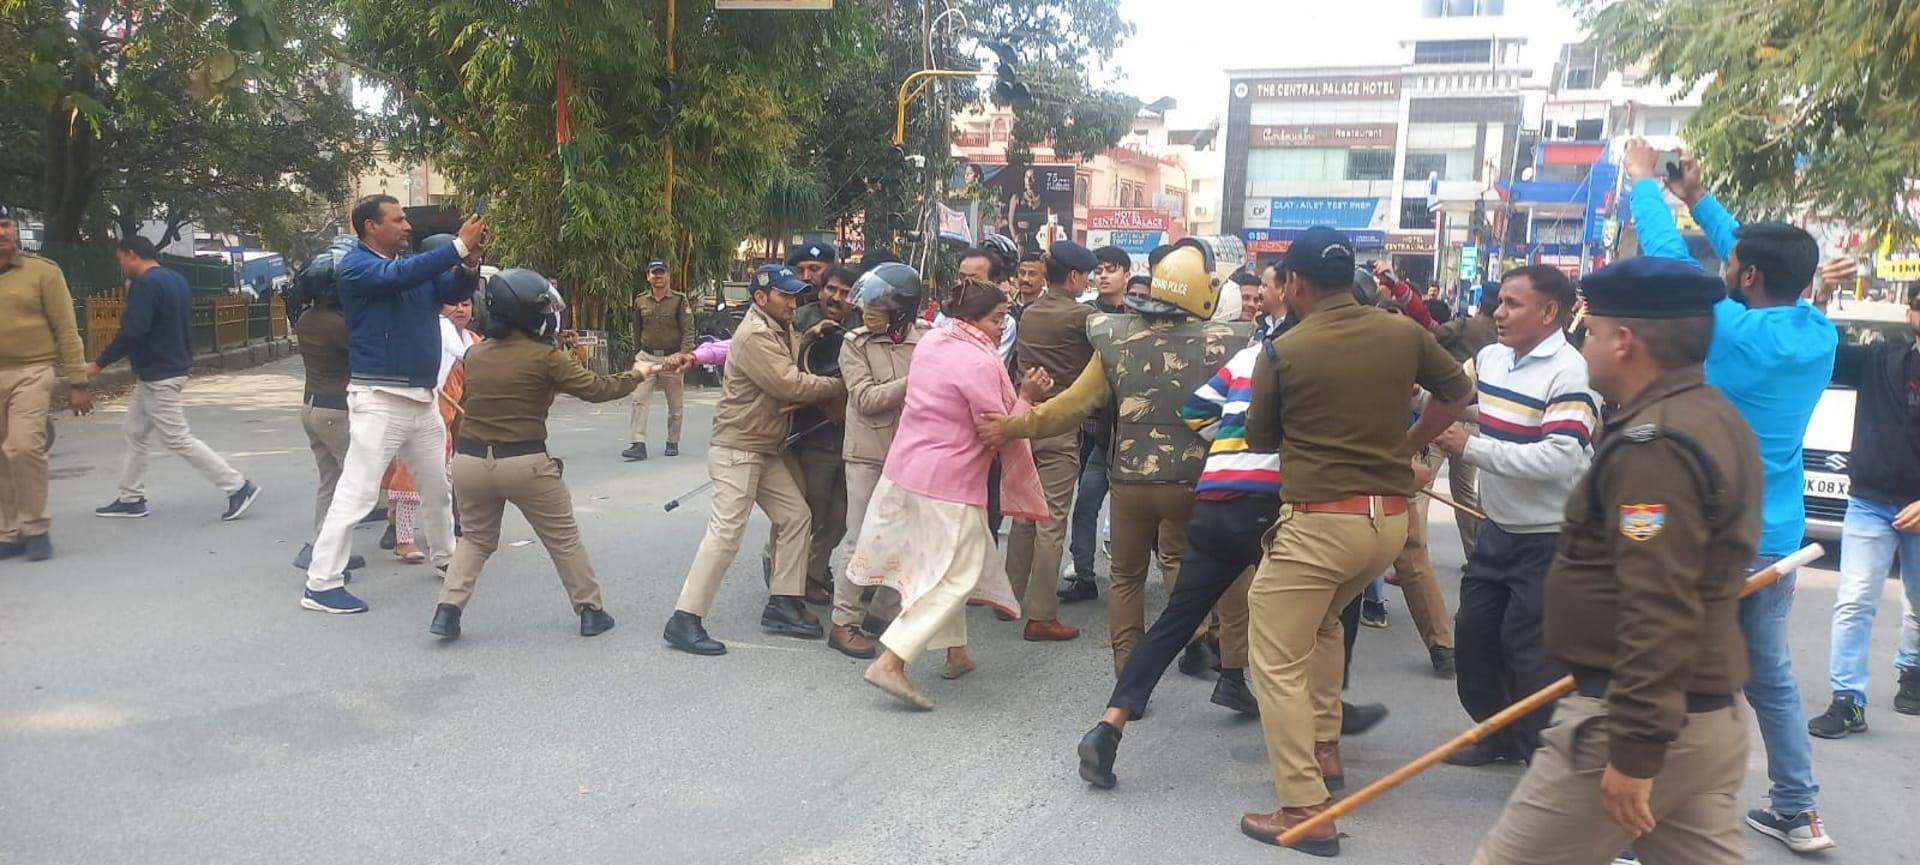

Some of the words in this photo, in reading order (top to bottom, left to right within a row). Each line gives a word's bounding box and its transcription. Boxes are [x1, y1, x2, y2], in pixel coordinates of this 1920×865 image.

[1257, 84, 1275, 97] THE
[1277, 82, 1321, 97] CENTRAL
[1322, 81, 1360, 96] PALACE
[1362, 81, 1395, 95] HOTEL
[1335, 128, 1382, 138] Restaurant
[1327, 201, 1347, 210] TEST
[1349, 201, 1371, 210] PREP
[1114, 210, 1140, 219] HOTEL
[1092, 218, 1130, 226] CENTRAL
[1132, 217, 1162, 226] PALACE
[1385, 243, 1414, 251] CENTRAL
[1168, 280, 1189, 296] POLICE
[1817, 480, 1835, 494] 08
